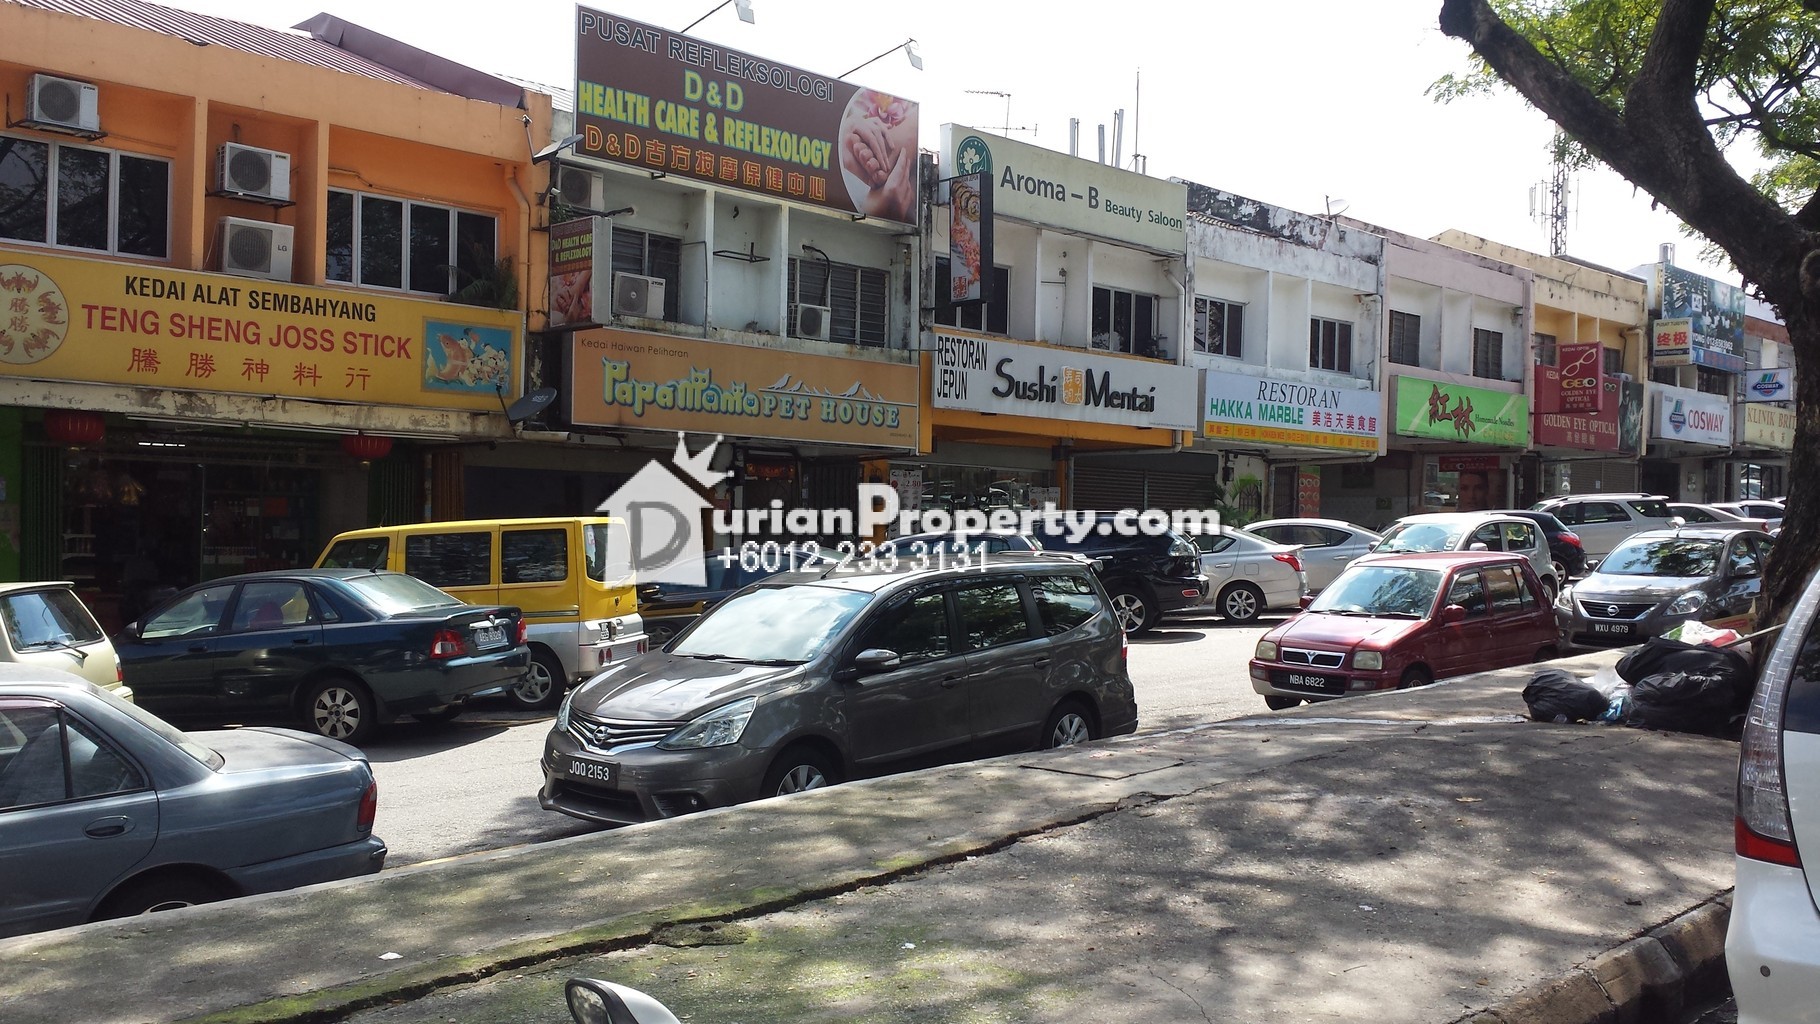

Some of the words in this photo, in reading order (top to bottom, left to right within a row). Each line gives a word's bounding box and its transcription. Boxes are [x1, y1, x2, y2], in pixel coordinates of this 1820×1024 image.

[580, 12, 661, 53] PUSAT
[668, 36, 834, 102] REFLEKSOLOGI
[578, 80, 650, 128] HEALTH
[655, 101, 700, 140] CARE
[704, 114, 720, 145] &
[724, 117, 832, 170] REFLEXOLOGY
[1000, 166, 1066, 202] Aroma
[1088, 186, 1099, 210] B
[1105, 199, 1142, 223] Beauty
[1148, 210, 1183, 229] Saloon
[277, 244, 288, 252] LG
[562, 235, 579, 249] HEALTH
[125, 276, 186, 301] KEDAI
[193, 283, 241, 307] ALAT
[248, 289, 377, 323] SEMBAHYANG
[82, 304, 160, 336] TENG
[169, 312, 261, 346] SHENG
[268, 323, 336, 352] JOSS
[343, 331, 412, 361] STICK
[581, 338, 608, 351] Kedai
[611, 340, 645, 354] Haiwan
[647, 345, 689, 358] Peliharan
[937, 336, 987, 371] RESTORAN
[936, 369, 968, 400] JEPUN
[992, 358, 1057, 404] Sushi
[1084, 369, 1156, 413] Mentai
[1546, 371, 1559, 380] KEDA
[1257, 380, 1341, 409] RESTORAN
[761, 391, 812, 420] PET
[820, 398, 901, 428] HOUSE
[1210, 398, 1253, 419] HAKKA
[1258, 402, 1304, 425] MARBLE
[1688, 409, 1725, 433] COSWAY
[1747, 407, 1775, 426] KLINIK
[1778, 413, 1797, 429] BRIT
[1543, 414, 1571, 428] GOLDEN
[1574, 417, 1587, 430] EYE
[1589, 420, 1616, 434] OPTICAL
[1594, 623, 1609, 632] WXU
[1611, 624, 1629, 633] 4979
[1290, 674, 1304, 685] NBA
[1305, 676, 1325, 688] 6822
[569, 760, 586, 776] JQQ
[587, 764, 610, 781] 2153
